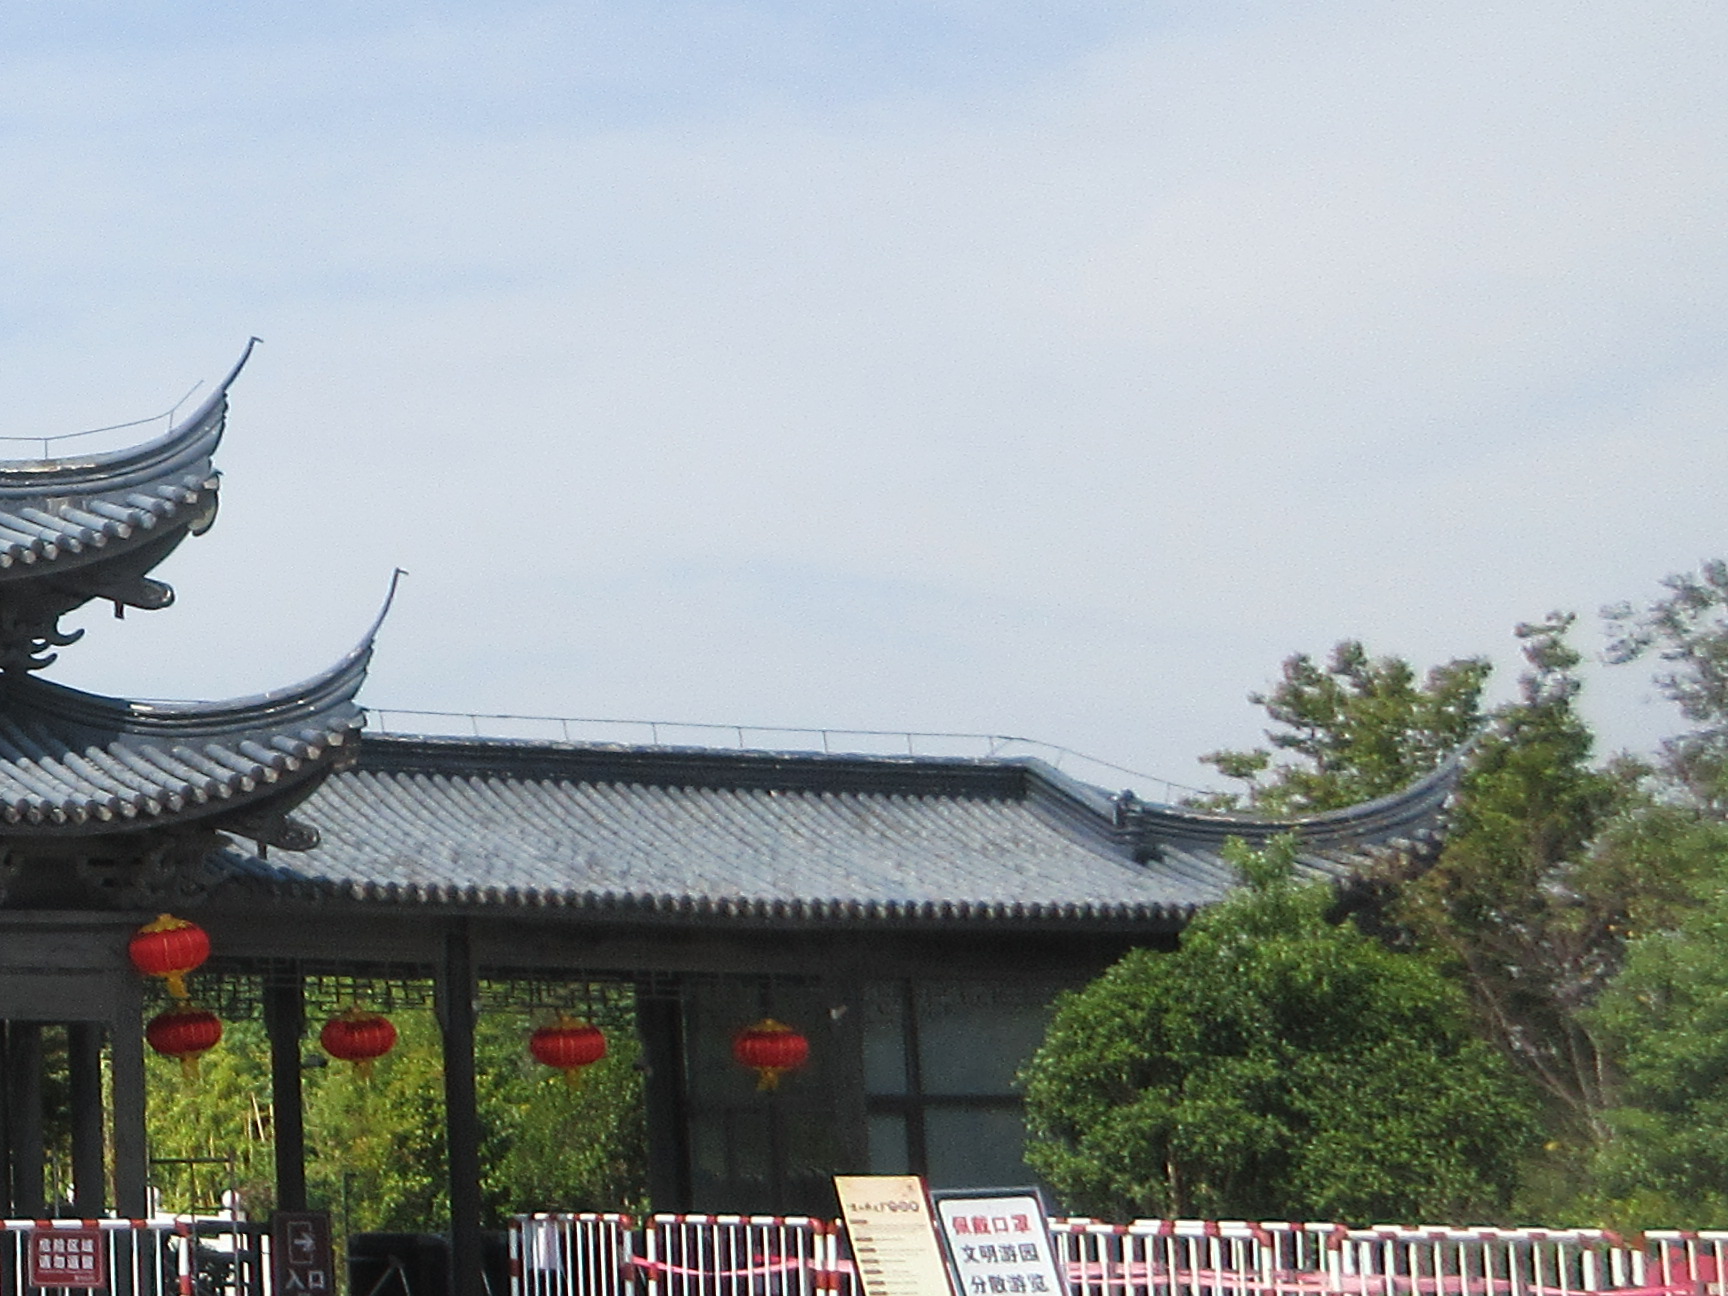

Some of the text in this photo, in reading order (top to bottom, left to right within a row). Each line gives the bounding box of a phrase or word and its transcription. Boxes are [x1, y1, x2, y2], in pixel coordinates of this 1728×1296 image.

[952, 1214, 1032, 1236] 佩戴口罩
[961, 1243, 1040, 1264] 文明游园
[284, 1268, 326, 1290] 入口
[970, 1273, 1050, 1295] 分散游览
